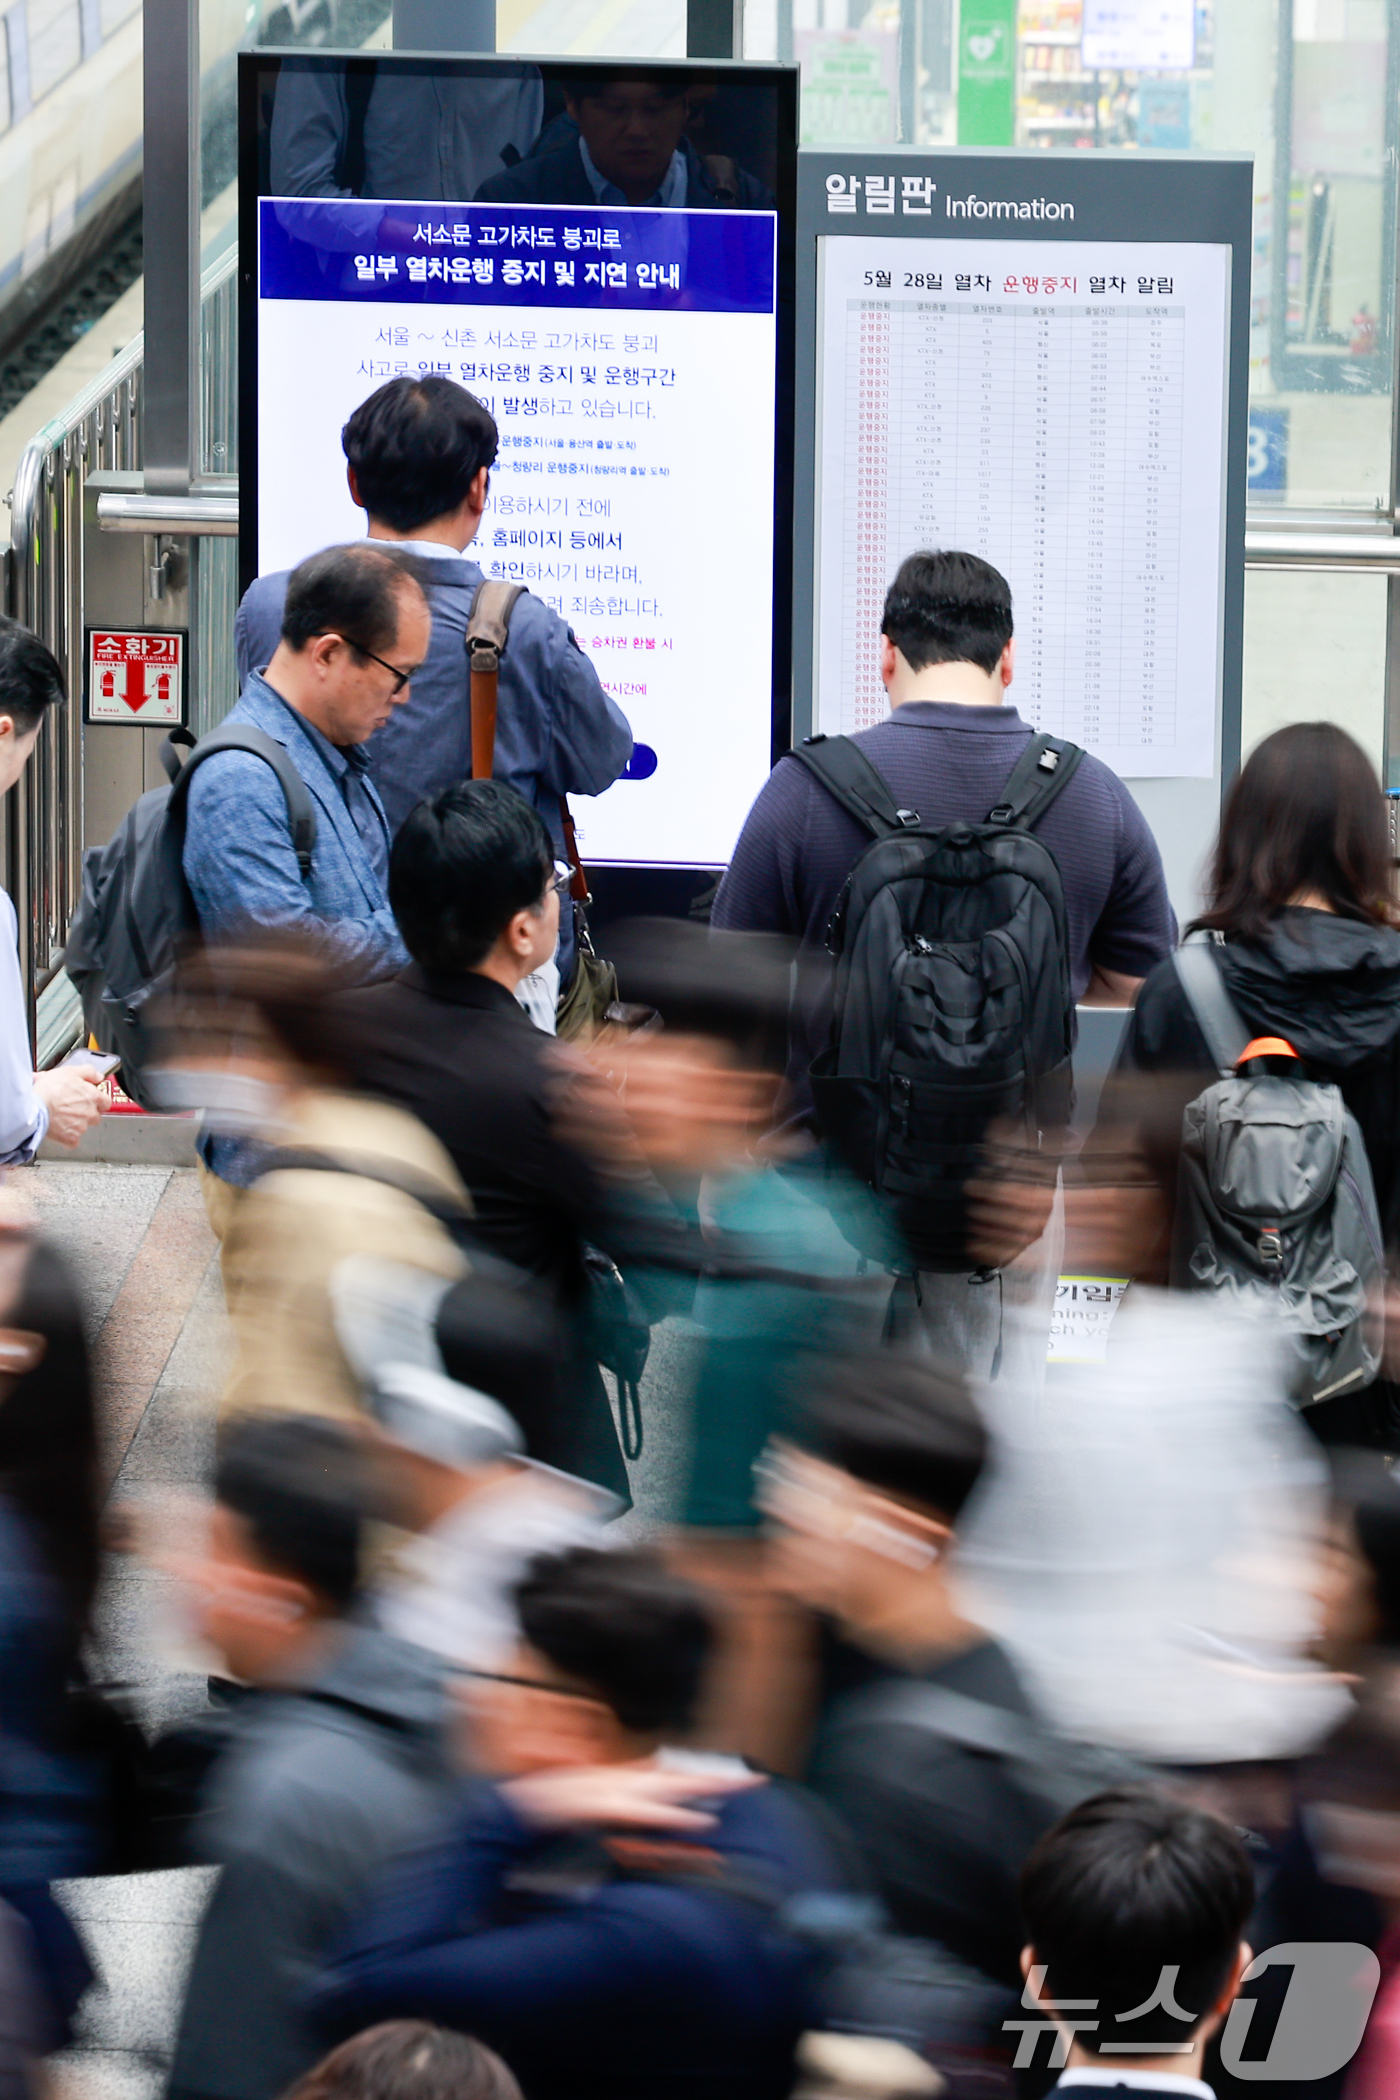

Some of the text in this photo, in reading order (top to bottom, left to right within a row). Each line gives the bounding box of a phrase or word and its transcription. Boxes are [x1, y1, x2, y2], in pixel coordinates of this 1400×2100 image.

[826, 174, 1074, 220] 알림판 Information
[412, 222, 622, 251] 서소문 고가차도 붕괴로
[354, 255, 680, 290] 일부 열차운행 중지 및 지연 안내
[864, 270, 1173, 294] 5월 28일 열차 운행중지 열차 알림
[375, 327, 410, 346] 서울
[442, 329, 477, 348] 신촌
[485, 330, 537, 349] 서소문
[544, 332, 615, 352] 고가차도
[623, 334, 658, 353] 붕괴
[356, 358, 676, 386] 사고로 일부 열차운행 중지 및 운행구간
[503, 397, 571, 416] 발생하고
[581, 398, 656, 419] 있습니다.
[576, 498, 610, 517] 전에
[492, 528, 562, 549] 홈페이지
[570, 531, 622, 550] 등에서
[488, 560, 577, 583] 확인하시기
[571, 596, 662, 617] 죄송합니다.
[97, 636, 175, 656] 소화기
[592, 636, 627, 649] 승차권
[633, 637, 656, 650] 환불
[661, 638, 673, 650] 시
[117, 654, 175, 662] EXTINGUISHER
